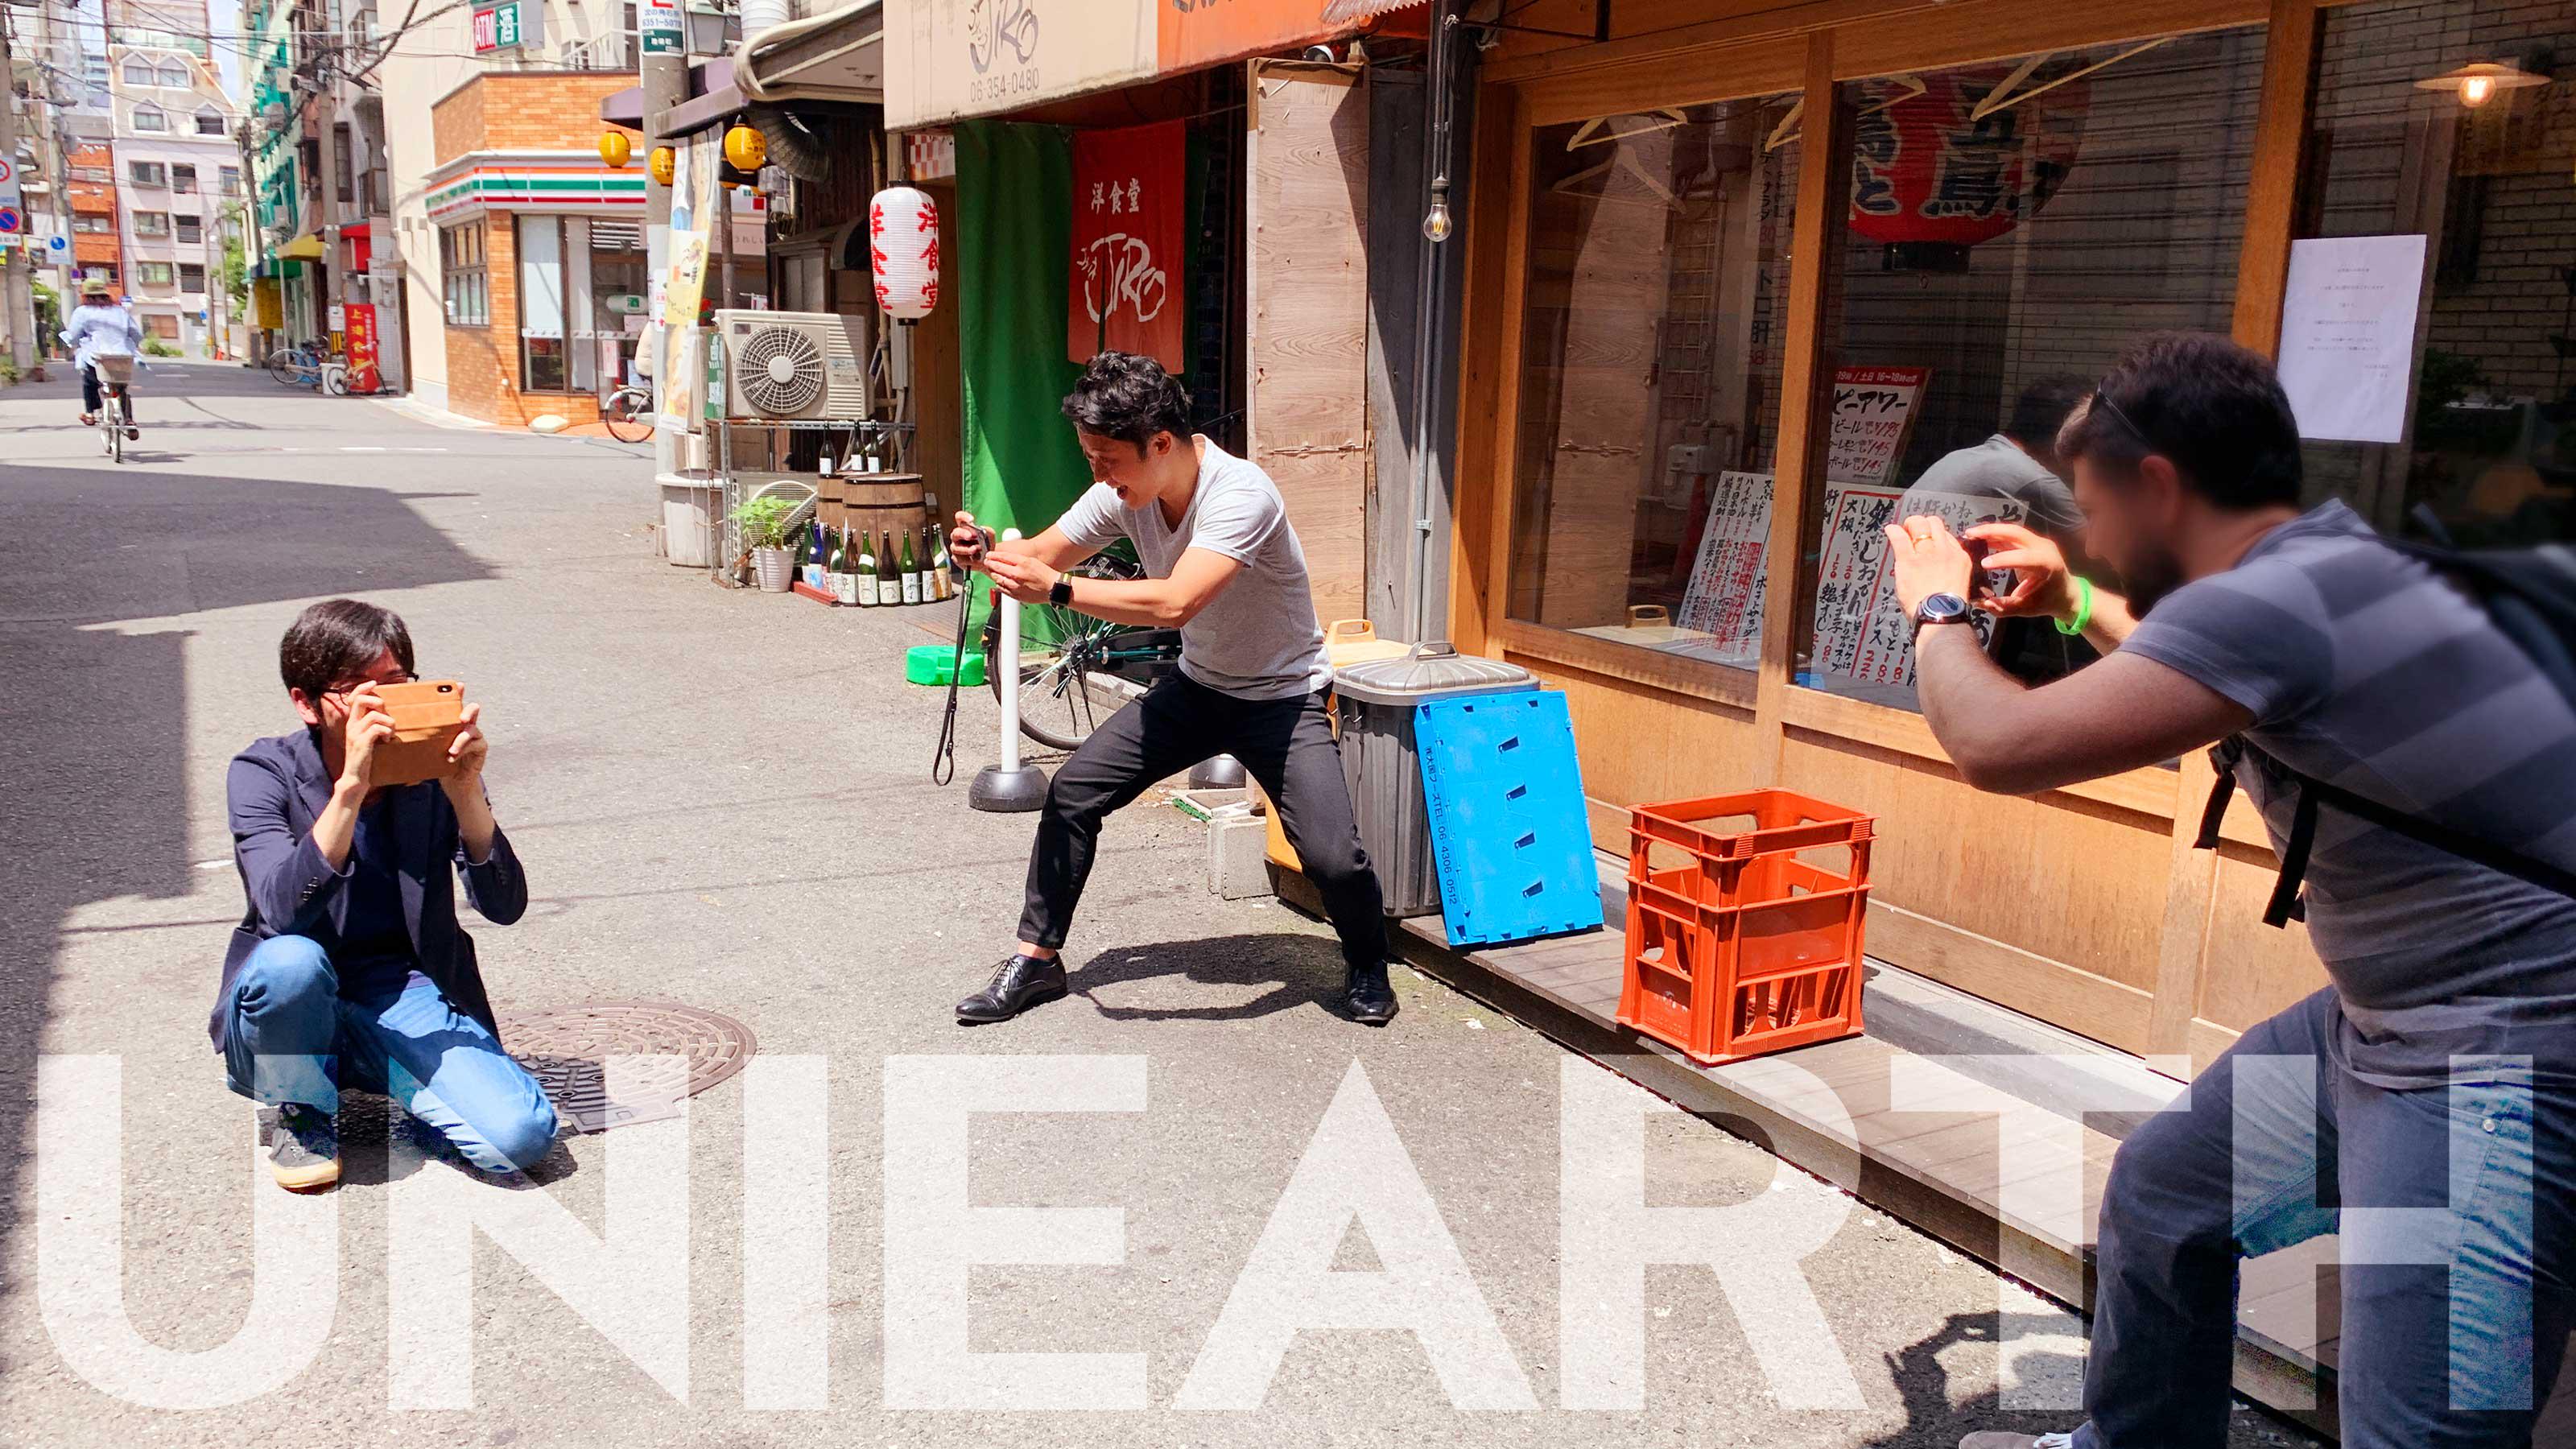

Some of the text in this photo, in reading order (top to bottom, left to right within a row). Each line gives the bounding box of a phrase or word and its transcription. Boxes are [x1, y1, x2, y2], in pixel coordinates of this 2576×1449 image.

[475, 13, 495, 48] ATM
[499, 7, 514, 43] 酒
[1091, 178, 1141, 214] 洋食堂
